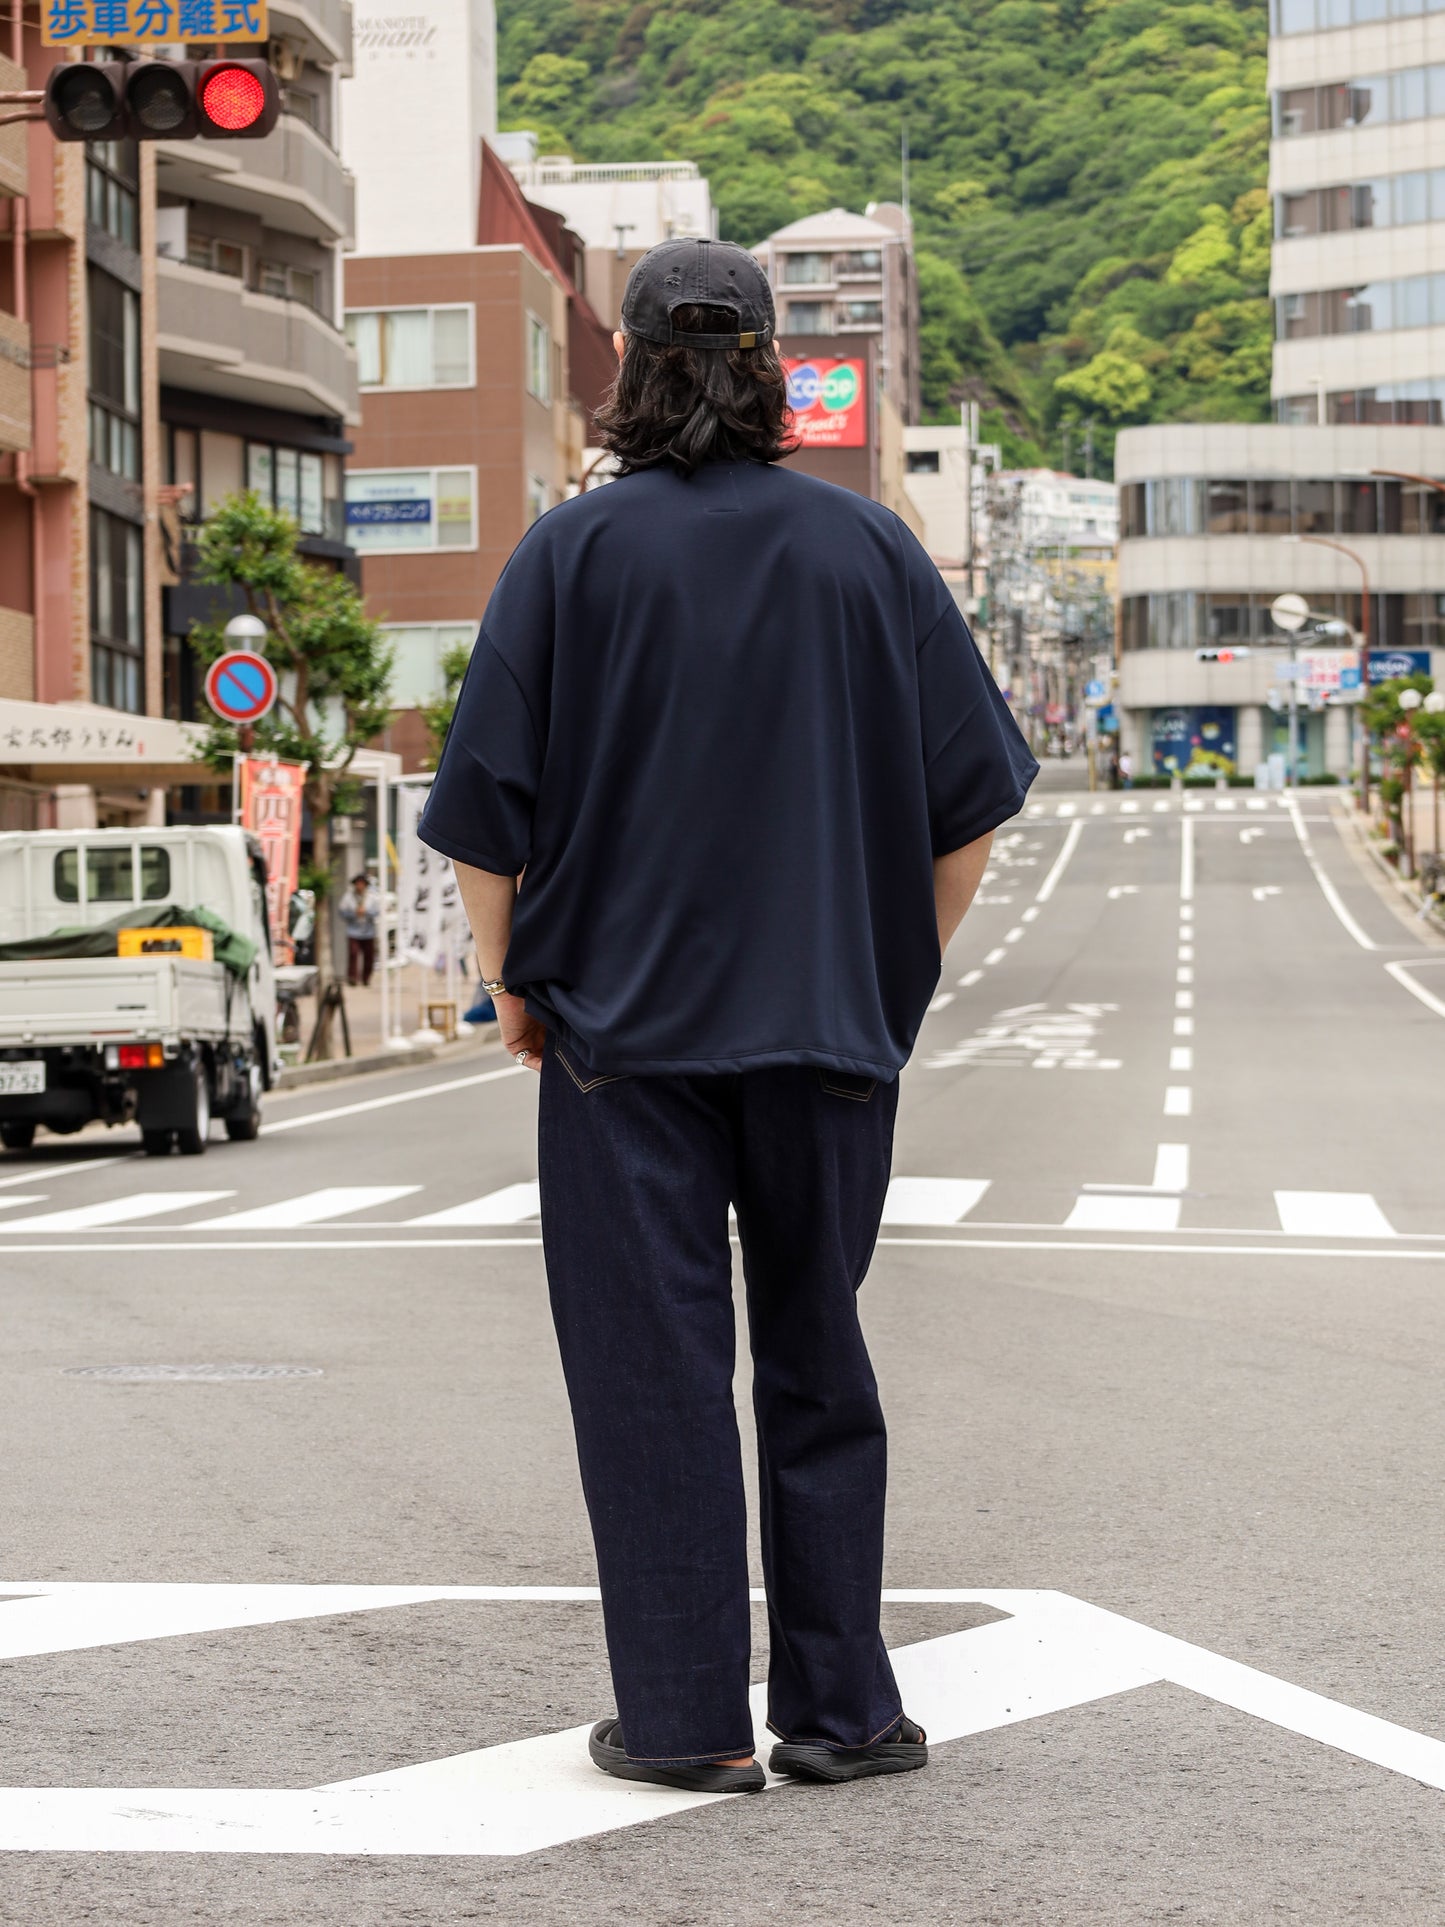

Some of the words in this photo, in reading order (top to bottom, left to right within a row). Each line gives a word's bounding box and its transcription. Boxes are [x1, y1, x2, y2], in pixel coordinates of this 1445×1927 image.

[48, 0, 260, 39] 歩車分離式
